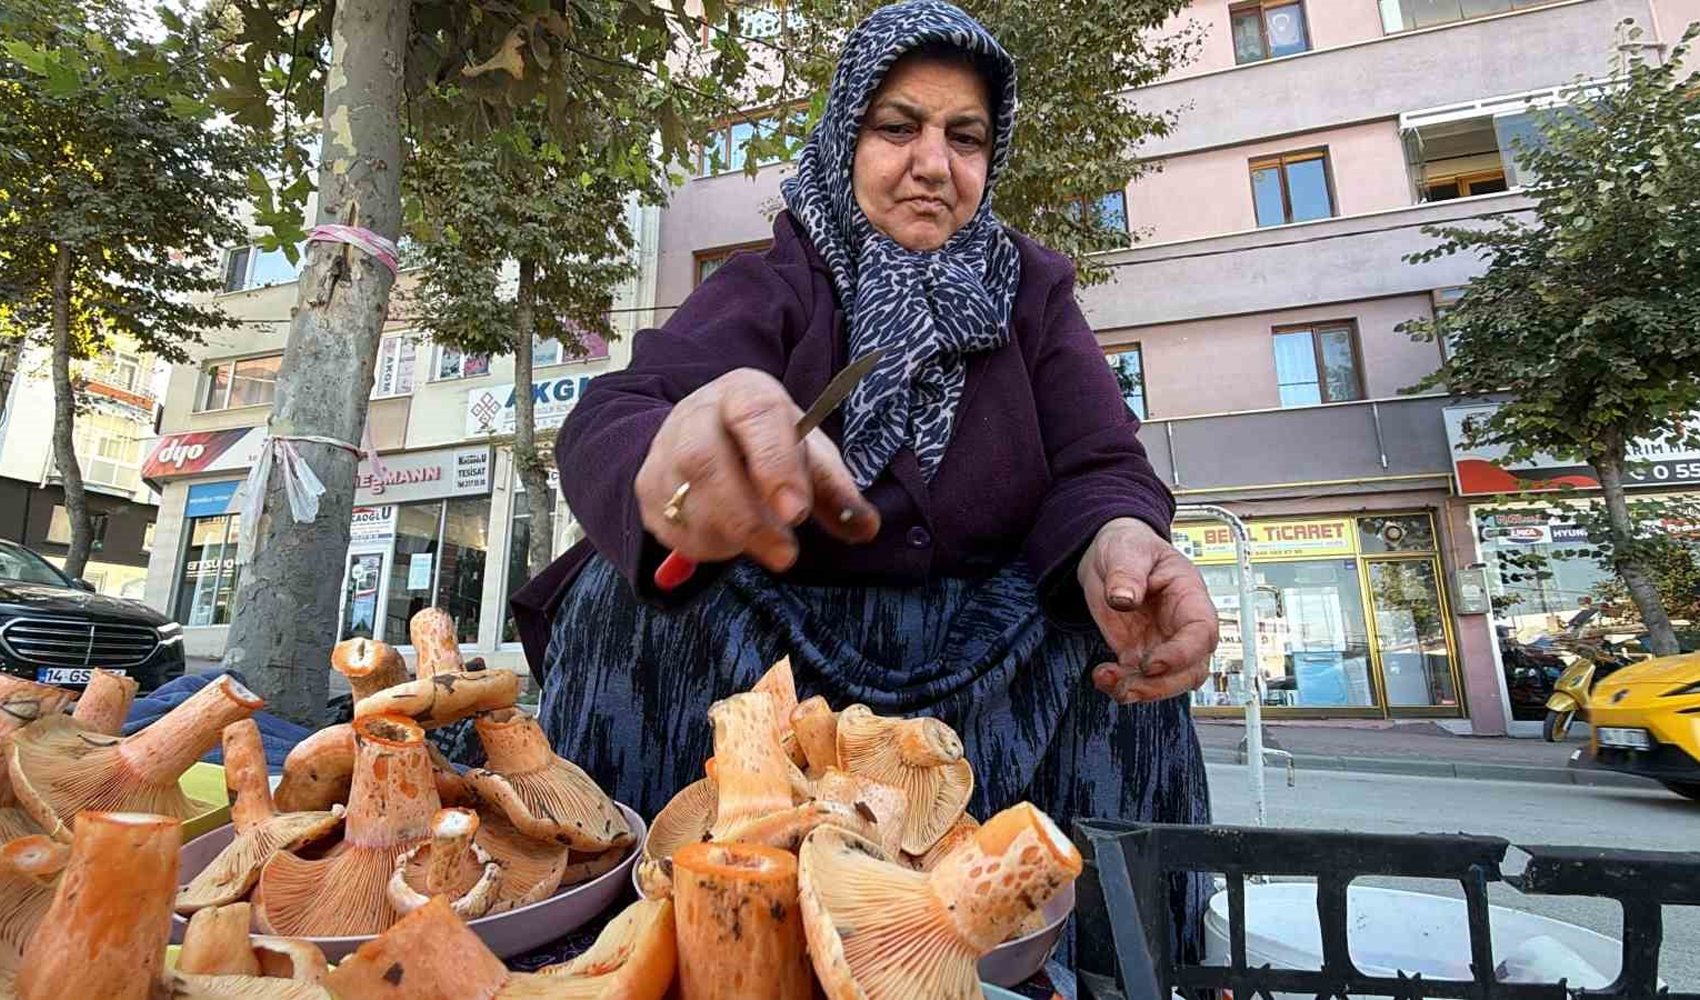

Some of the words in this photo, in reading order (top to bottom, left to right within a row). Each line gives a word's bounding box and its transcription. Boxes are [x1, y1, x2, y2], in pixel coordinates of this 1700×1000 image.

[158, 439, 205, 468] dyo
[1653, 465, 1669, 479] 0
[47, 669, 62, 682] 14
